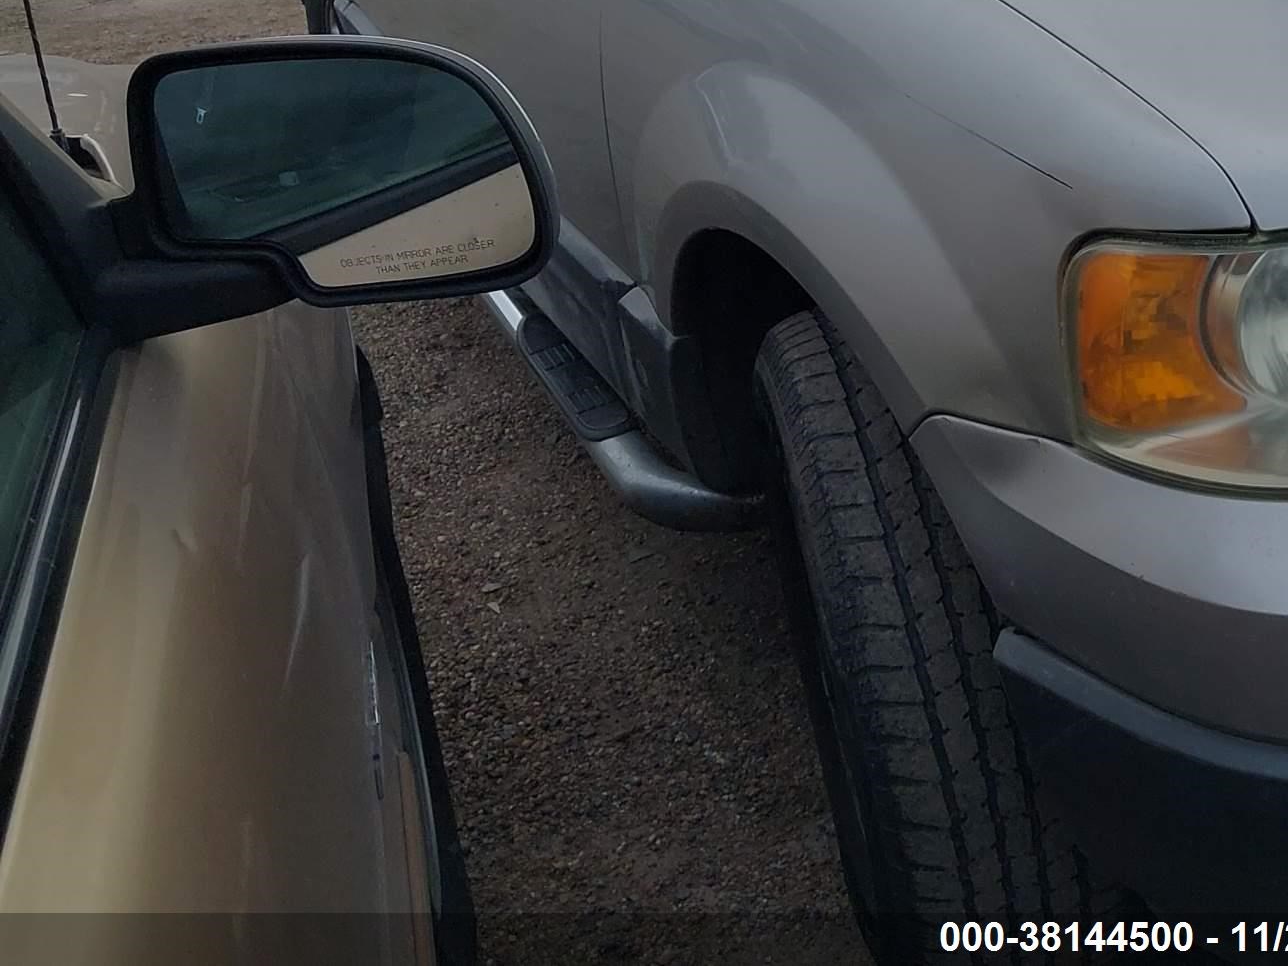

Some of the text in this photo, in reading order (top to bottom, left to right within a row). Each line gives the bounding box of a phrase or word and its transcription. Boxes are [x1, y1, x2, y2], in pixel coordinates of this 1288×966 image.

[339, 240, 496, 268] OBJECTS IN MIRROR ARE CLOSER
[376, 255, 469, 275] THAN THEY APPEAR
